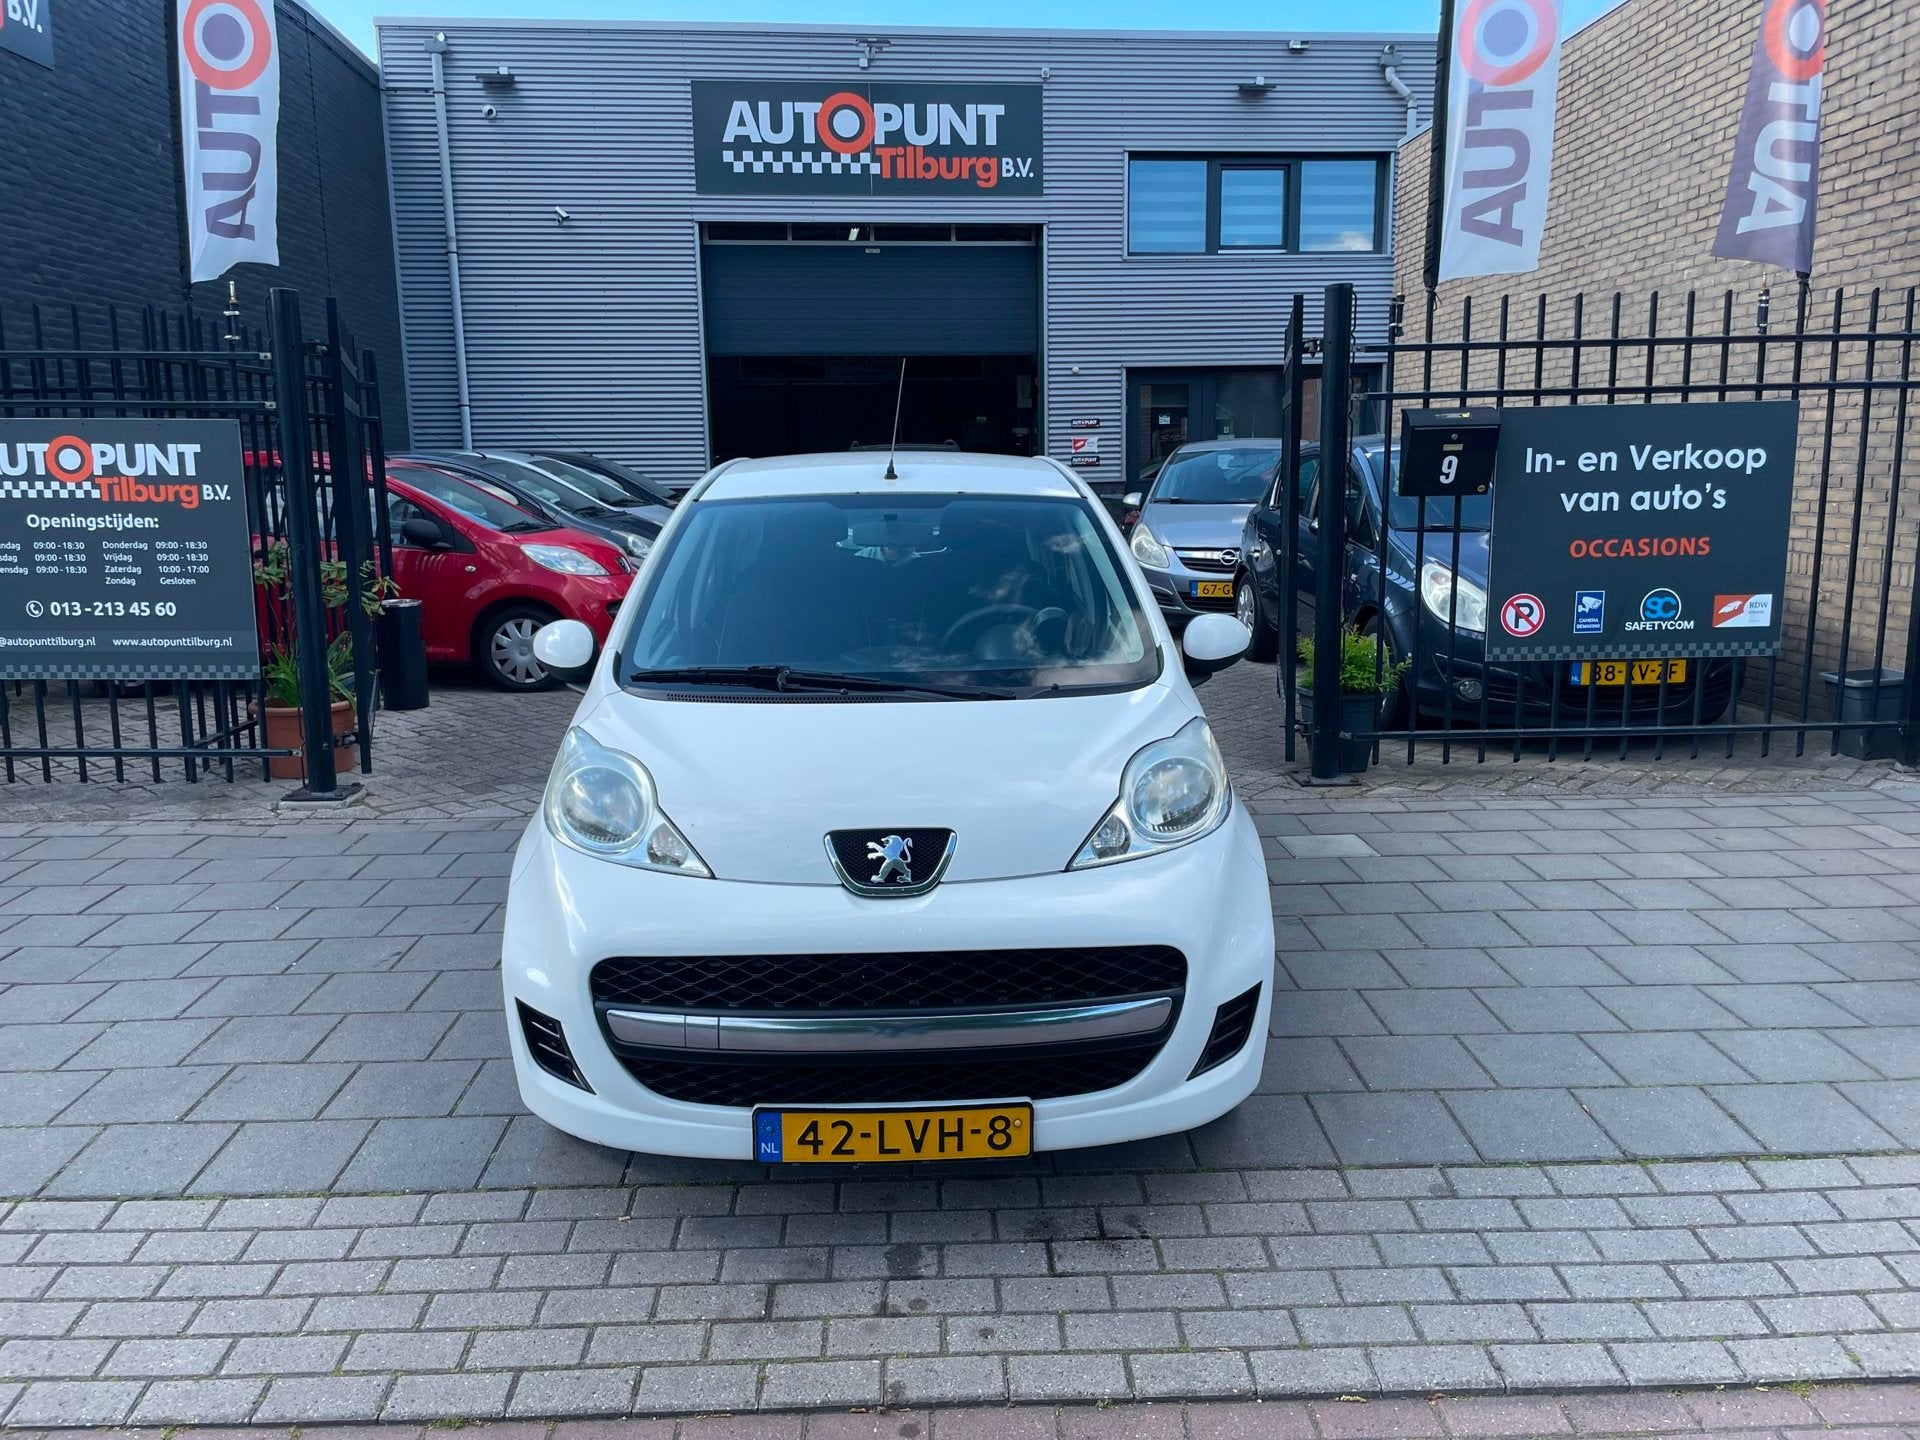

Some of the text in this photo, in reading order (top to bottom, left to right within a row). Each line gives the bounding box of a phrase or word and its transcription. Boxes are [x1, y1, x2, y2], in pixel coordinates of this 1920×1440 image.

[722, 92, 1005, 154] AUTOPUNT
[875, 146, 1034, 188] Tilburg B.V.
[0, 435, 201, 483] UTOPUNT
[1525, 443, 1767, 475] In- en Verkoop
[1439, 455, 1458, 484] 9
[95, 476, 232, 509] Tilburg B.V.
[1560, 483, 1726, 512] van auto's
[26, 513, 159, 531] Openingstijden:
[33, 541, 56, 550] 09:00
[62, 541, 85, 550] 18:30
[102, 541, 148, 551] Donderdag
[155, 541, 179, 550] 09:00
[185, 541, 208, 550] 18:30
[1569, 537, 1711, 559] OCCASIONS
[34, 553, 58, 562] 09:00
[64, 553, 86, 562] 18:30
[103, 553, 133, 563] Vrijdag
[156, 553, 180, 562] 09:00
[186, 553, 209, 562] 18:30
[36, 565, 59, 574] 09:00
[65, 565, 88, 574] 18:30
[104, 565, 142, 575] Zaterdag
[158, 565, 181, 574] 10:00
[187, 565, 210, 574] 17:00
[105, 577, 196, 587] Zondag Gesloten
[129, 601, 150, 617] 45
[155, 601, 177, 617] 60
[1749, 601, 1769, 609] RDW
[1625, 620, 1695, 631] SAFETYCOM
[113, 636, 233, 648] www.autopunttilburg.nl
[797, 1115, 1012, 1156] 42-LVH-8
[761, 1142, 779, 1154] NL
